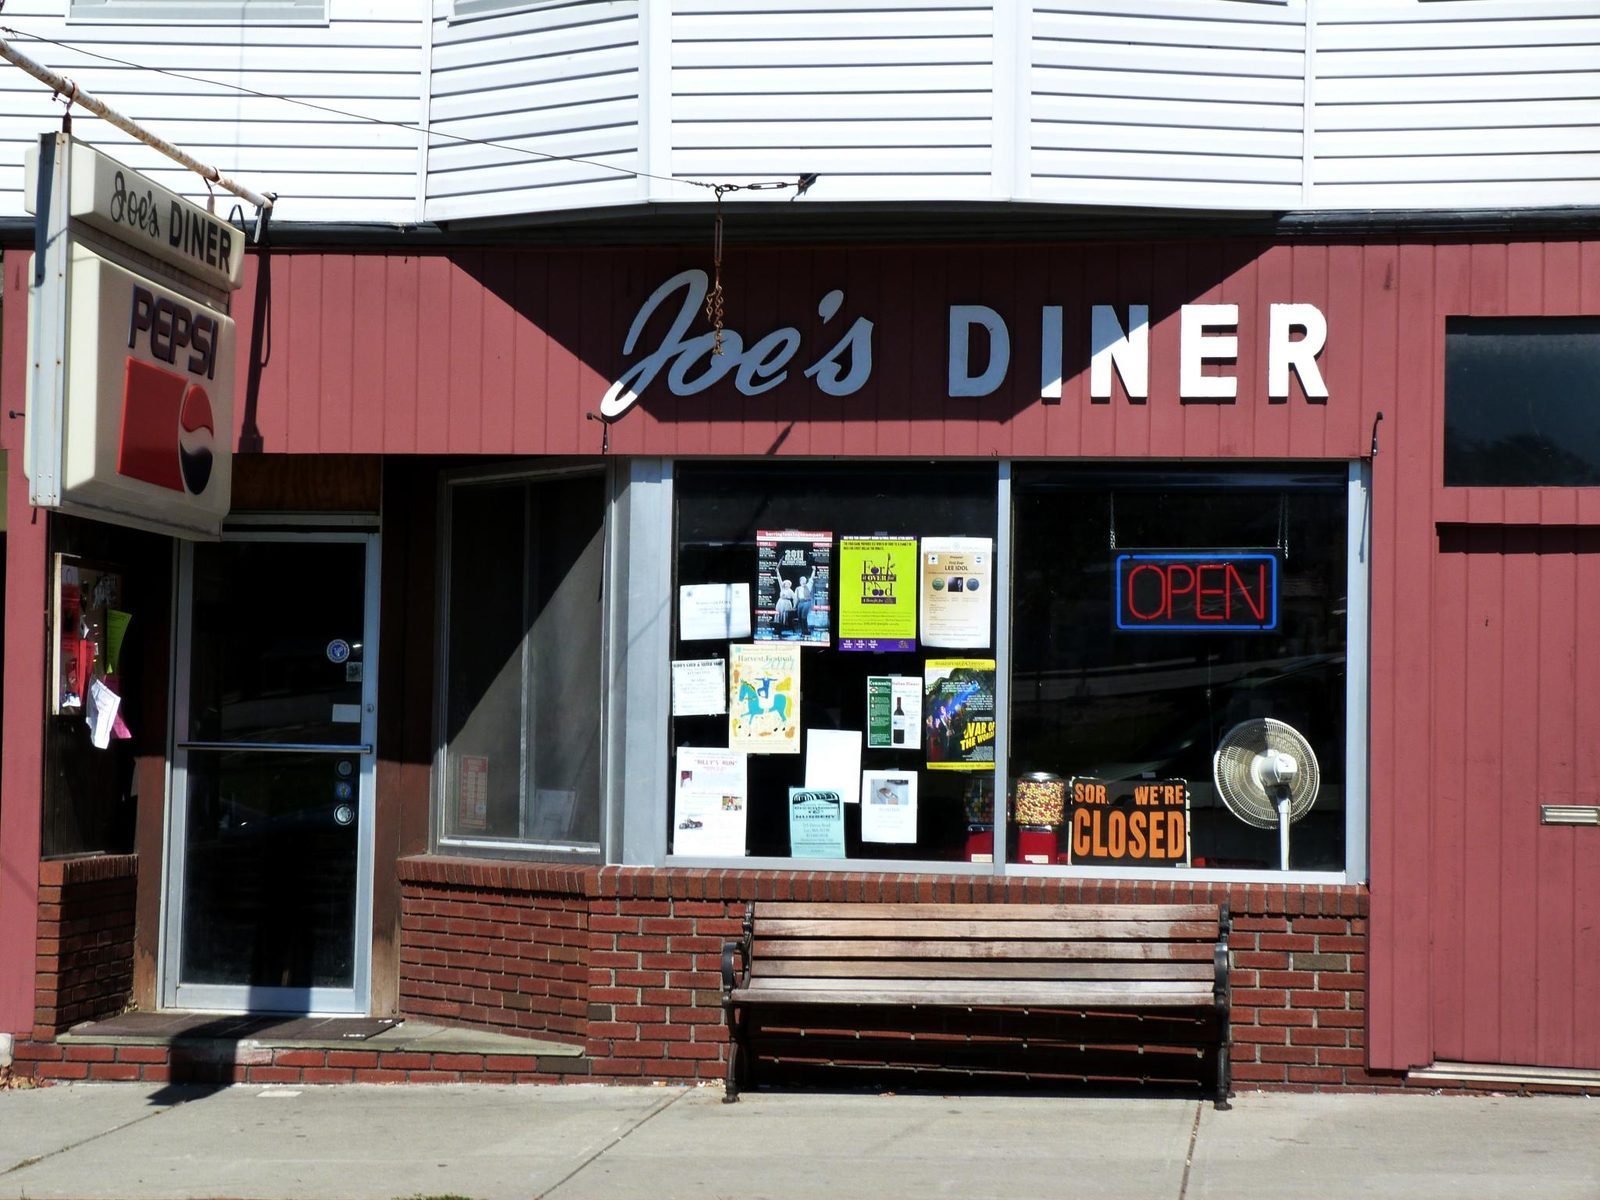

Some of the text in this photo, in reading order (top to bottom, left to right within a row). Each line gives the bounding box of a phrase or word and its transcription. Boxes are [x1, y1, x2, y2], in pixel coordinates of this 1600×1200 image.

[110, 170, 231, 274] Joe's DINER
[128, 283, 219, 380] PEPSI
[600, 269, 1329, 417] Joe's DINER
[1128, 564, 1265, 620] OPEN
[960, 737, 976, 751] THE
[964, 721, 987, 739] WAR
[1134, 784, 1184, 806] WE'RE
[1073, 808, 1185, 859] CLOSED
